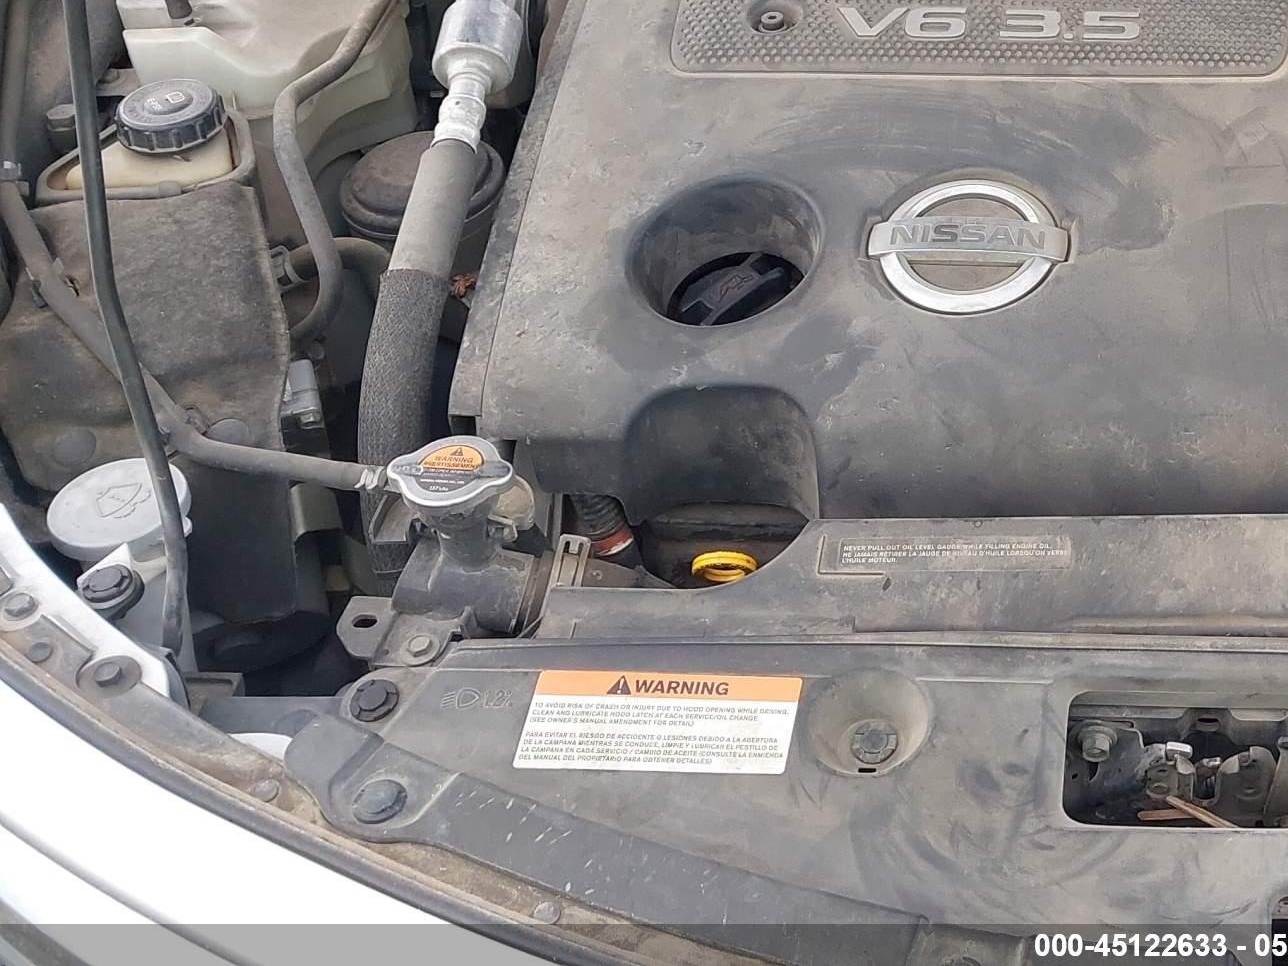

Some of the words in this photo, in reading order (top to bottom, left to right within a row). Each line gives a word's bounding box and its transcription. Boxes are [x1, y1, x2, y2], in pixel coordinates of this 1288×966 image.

[836, 6, 968, 39] V6
[998, 8, 1141, 43] 3.5
[889, 224, 1046, 249] NISSAN
[634, 679, 729, 696] WARNING
